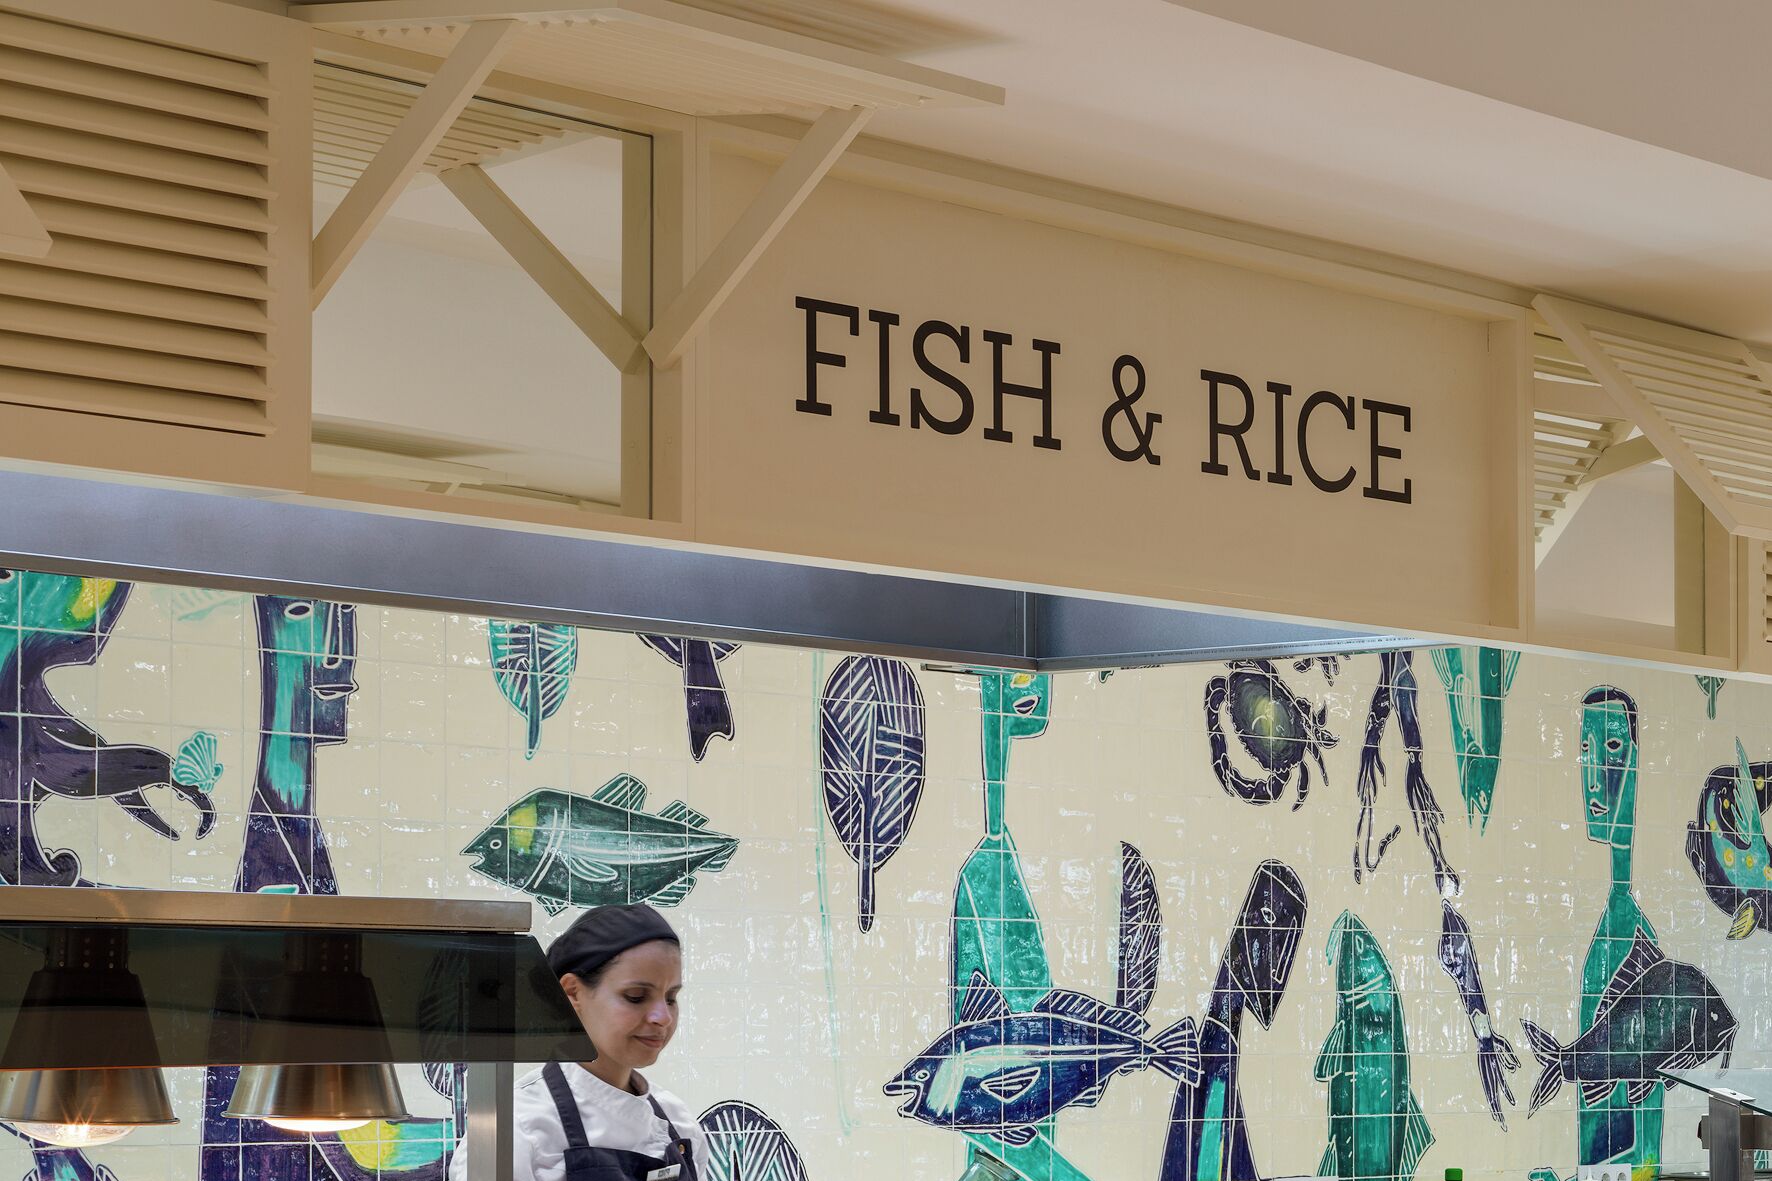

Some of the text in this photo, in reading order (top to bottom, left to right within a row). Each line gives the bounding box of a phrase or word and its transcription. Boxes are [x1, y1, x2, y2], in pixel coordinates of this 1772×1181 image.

[795, 296, 1412, 504] FISH & RICE
